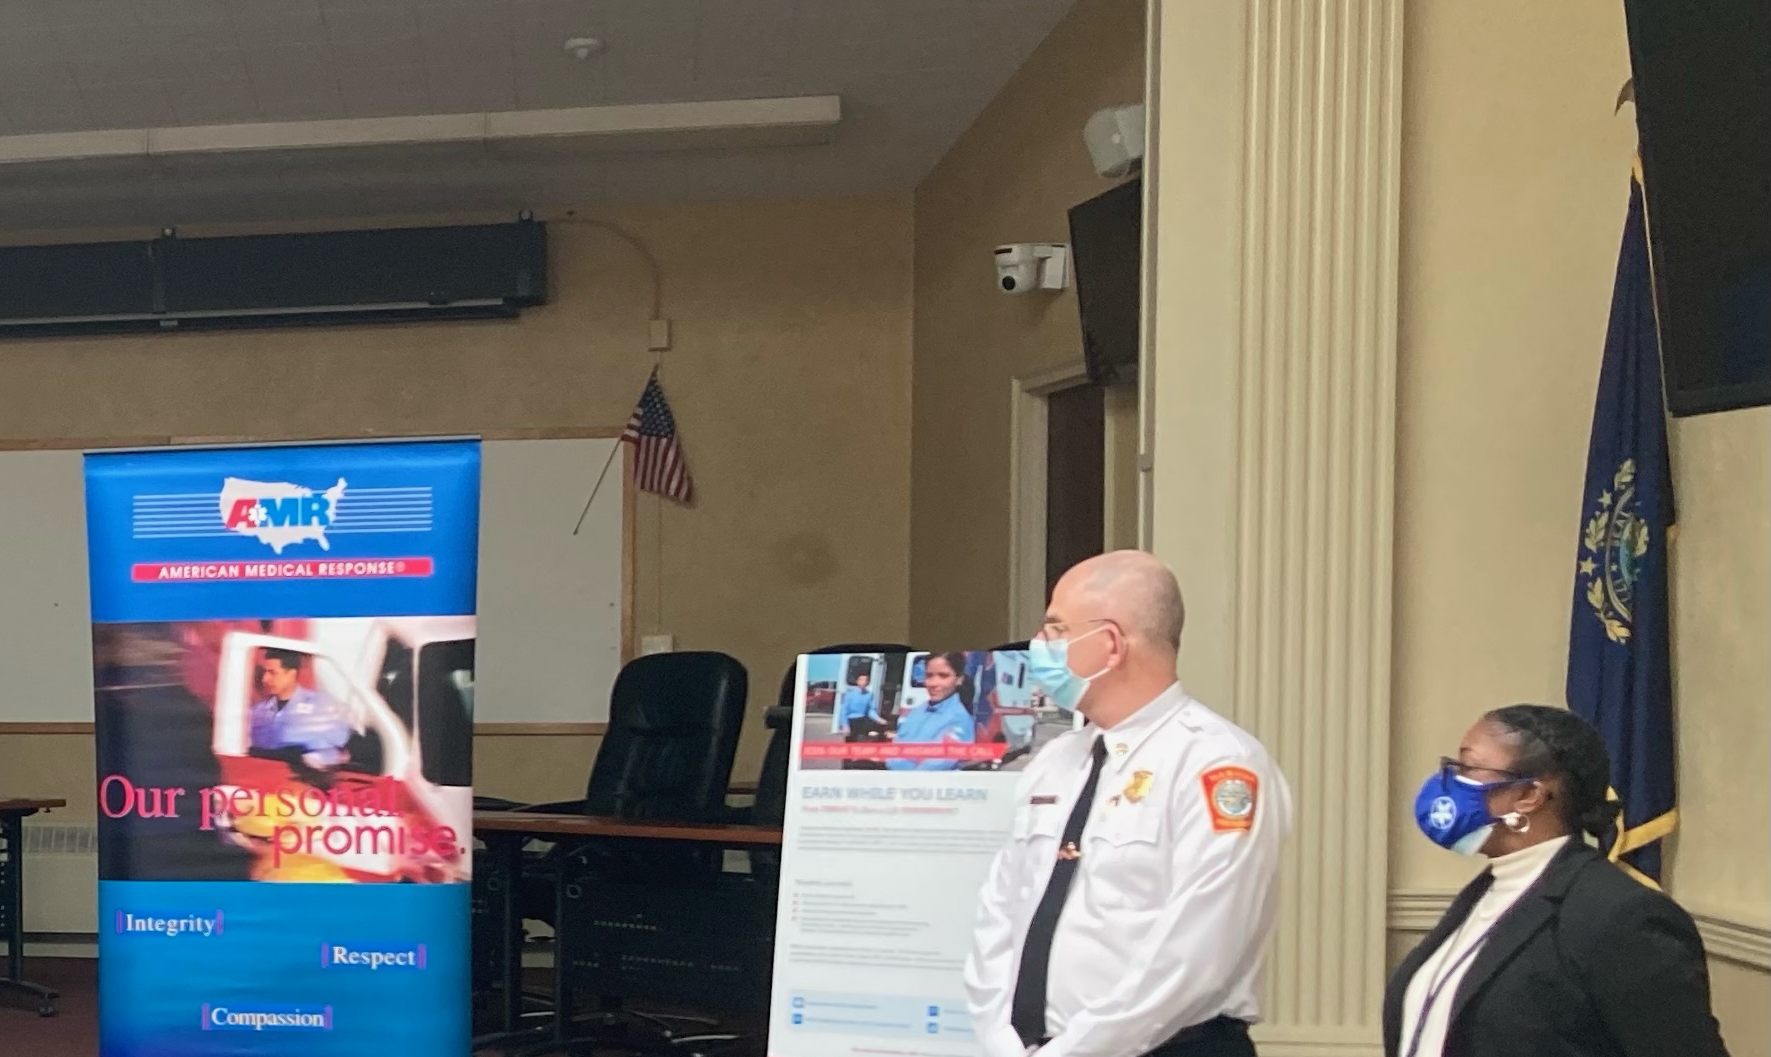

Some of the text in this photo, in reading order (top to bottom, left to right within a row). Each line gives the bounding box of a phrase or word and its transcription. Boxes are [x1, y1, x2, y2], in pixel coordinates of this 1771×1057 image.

[225, 497, 332, 529] AMR
[158, 563, 239, 579] AMERICAN
[245, 562, 313, 578] MEDICAL
[100, 775, 405, 831] Our personal
[802, 786, 988, 801] EARN WHILE YOU LEARN
[273, 822, 466, 869] promise.
[126, 913, 215, 937] Integrity
[332, 946, 416, 969] Respect
[211, 1006, 325, 1030] Compassion
